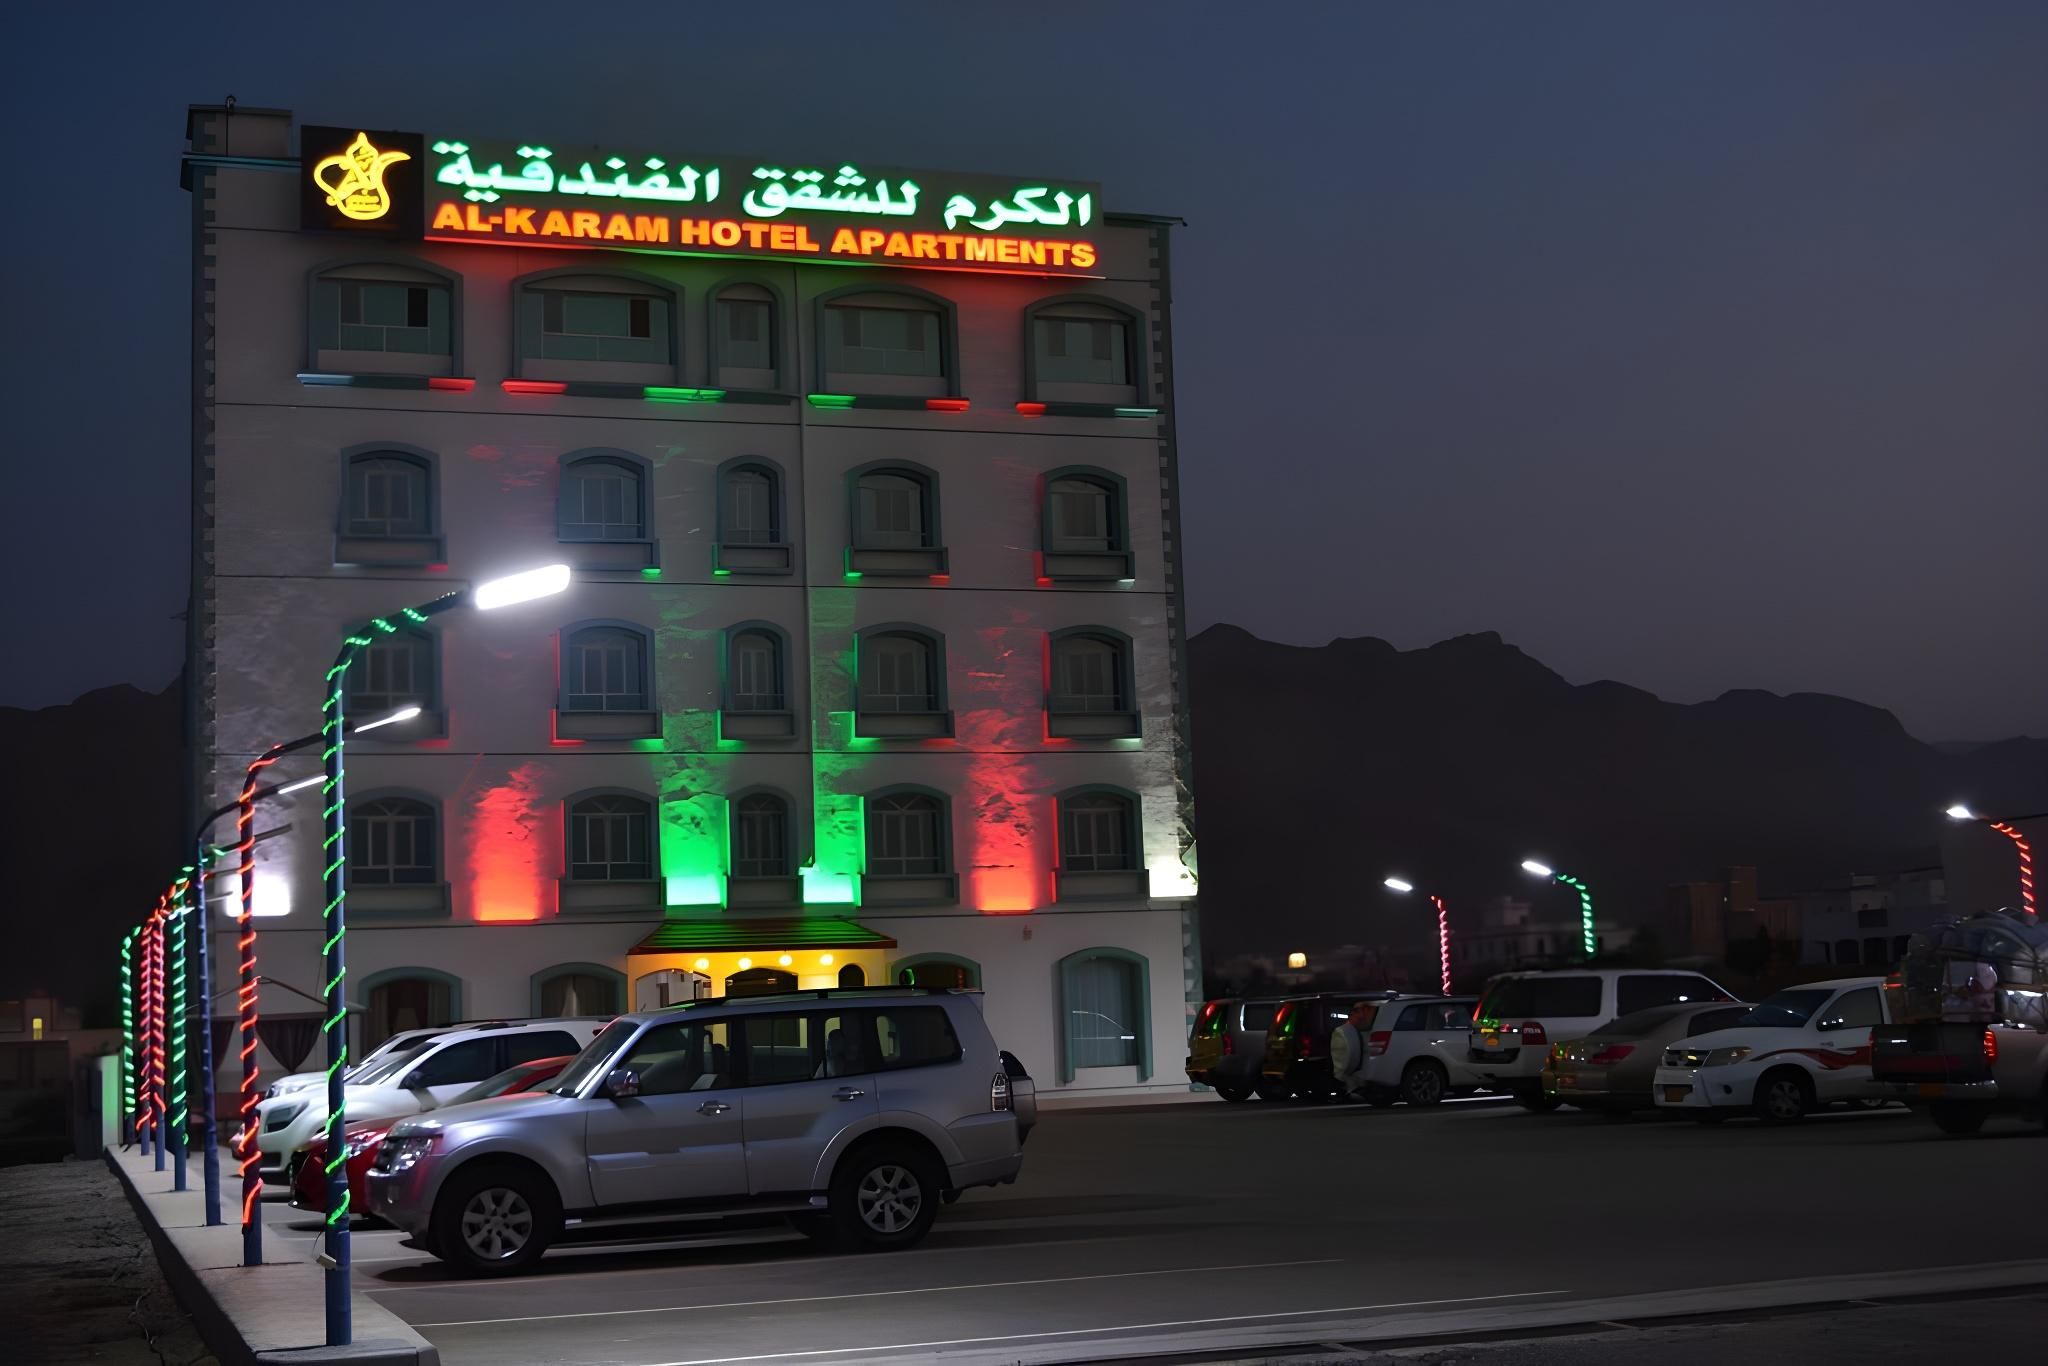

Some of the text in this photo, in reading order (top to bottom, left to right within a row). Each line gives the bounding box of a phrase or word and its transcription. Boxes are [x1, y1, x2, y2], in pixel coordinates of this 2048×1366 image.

[432, 140, 1092, 231] الكرم للشقق الفندقية
[432, 203, 1096, 268] AL-KARAM HOTEL APARTMENTS
